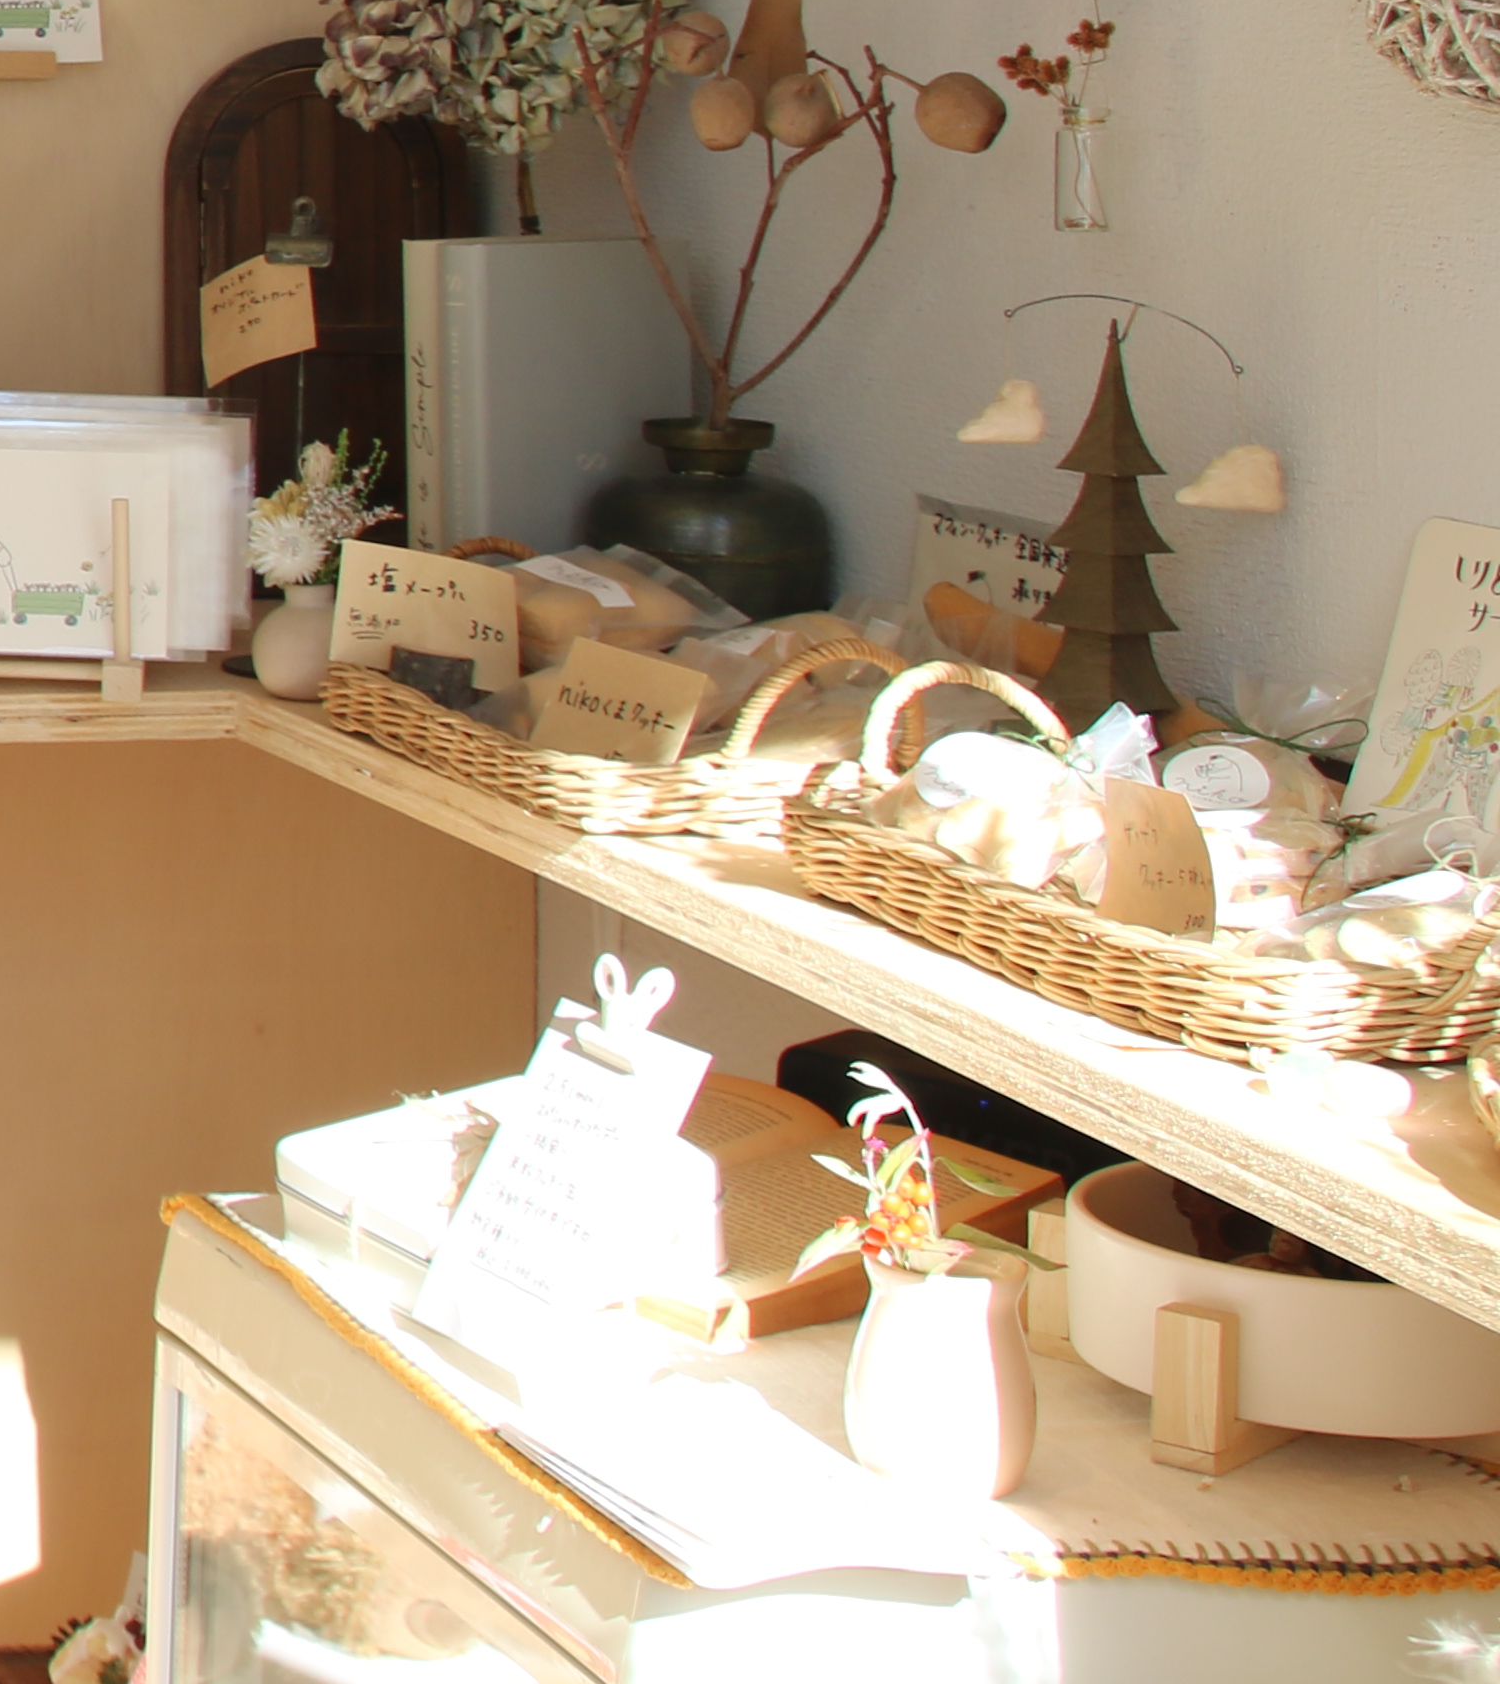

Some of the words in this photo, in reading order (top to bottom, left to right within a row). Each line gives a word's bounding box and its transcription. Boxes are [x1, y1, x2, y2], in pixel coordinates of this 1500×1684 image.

[367, 562, 466, 602] 塩メープル
[469, 619, 505, 643] 350
[558, 680, 676, 733] nikoくまクッキー
